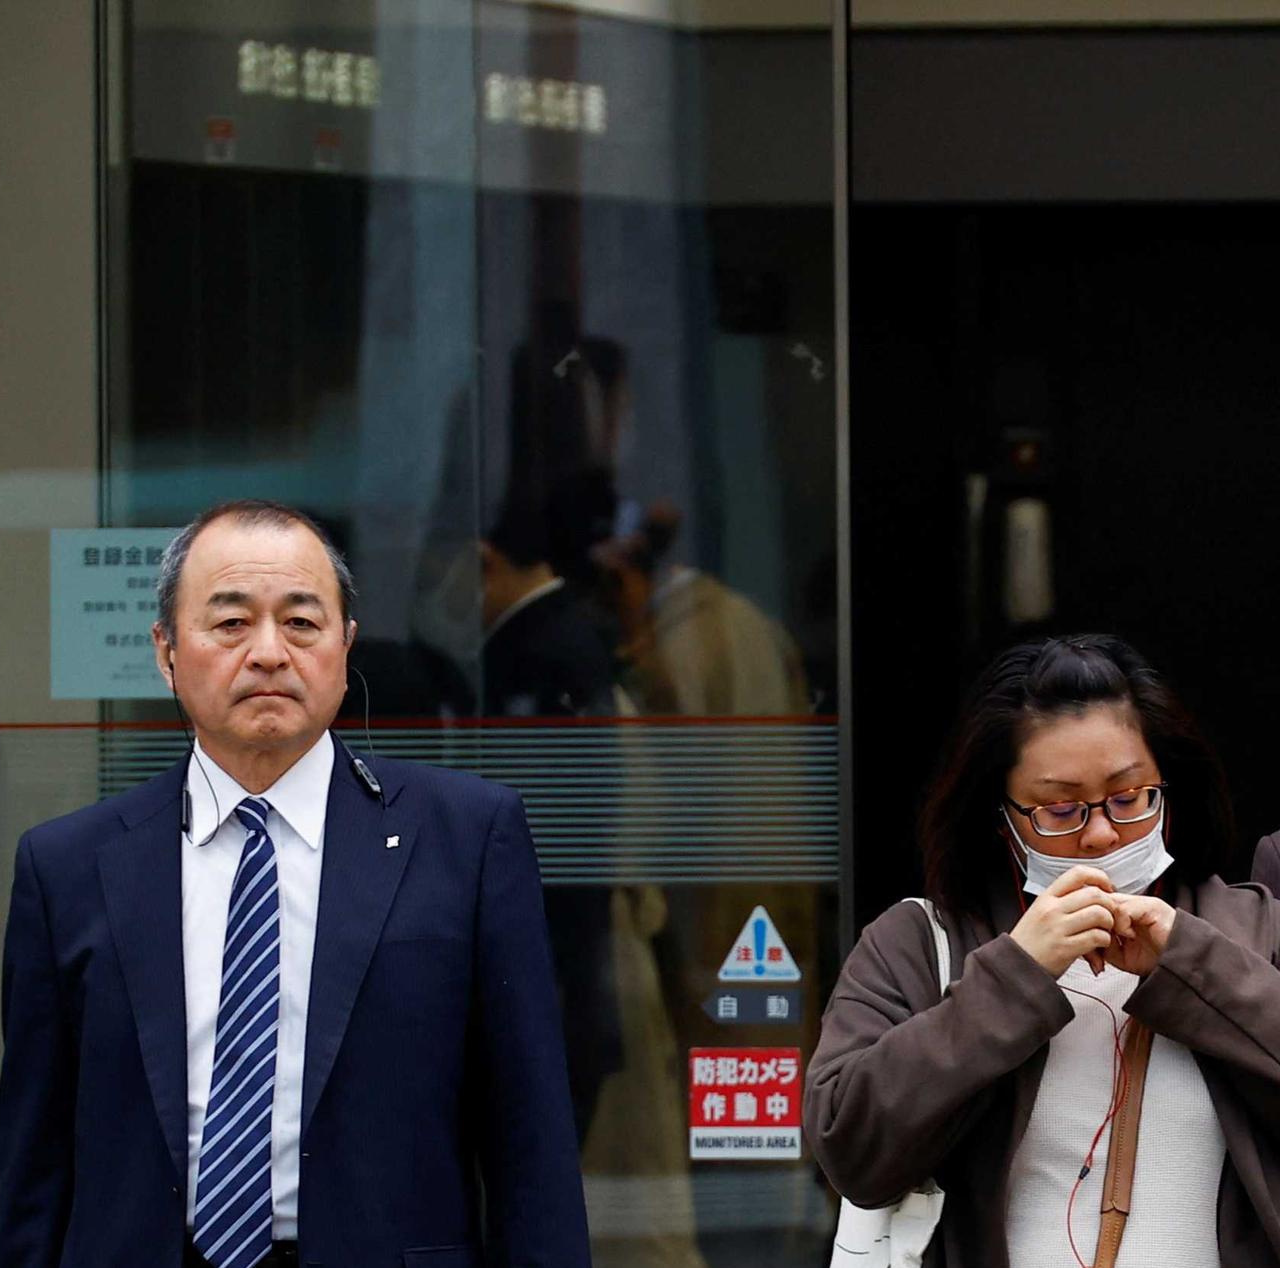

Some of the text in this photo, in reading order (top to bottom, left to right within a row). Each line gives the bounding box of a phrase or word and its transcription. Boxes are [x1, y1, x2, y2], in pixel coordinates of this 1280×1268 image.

[718, 995, 789, 1019] 自動
[693, 1057, 798, 1086] 防犯カメラ
[702, 1092, 789, 1121] 作動中
[696, 1136, 797, 1149] MONITORED AREA
